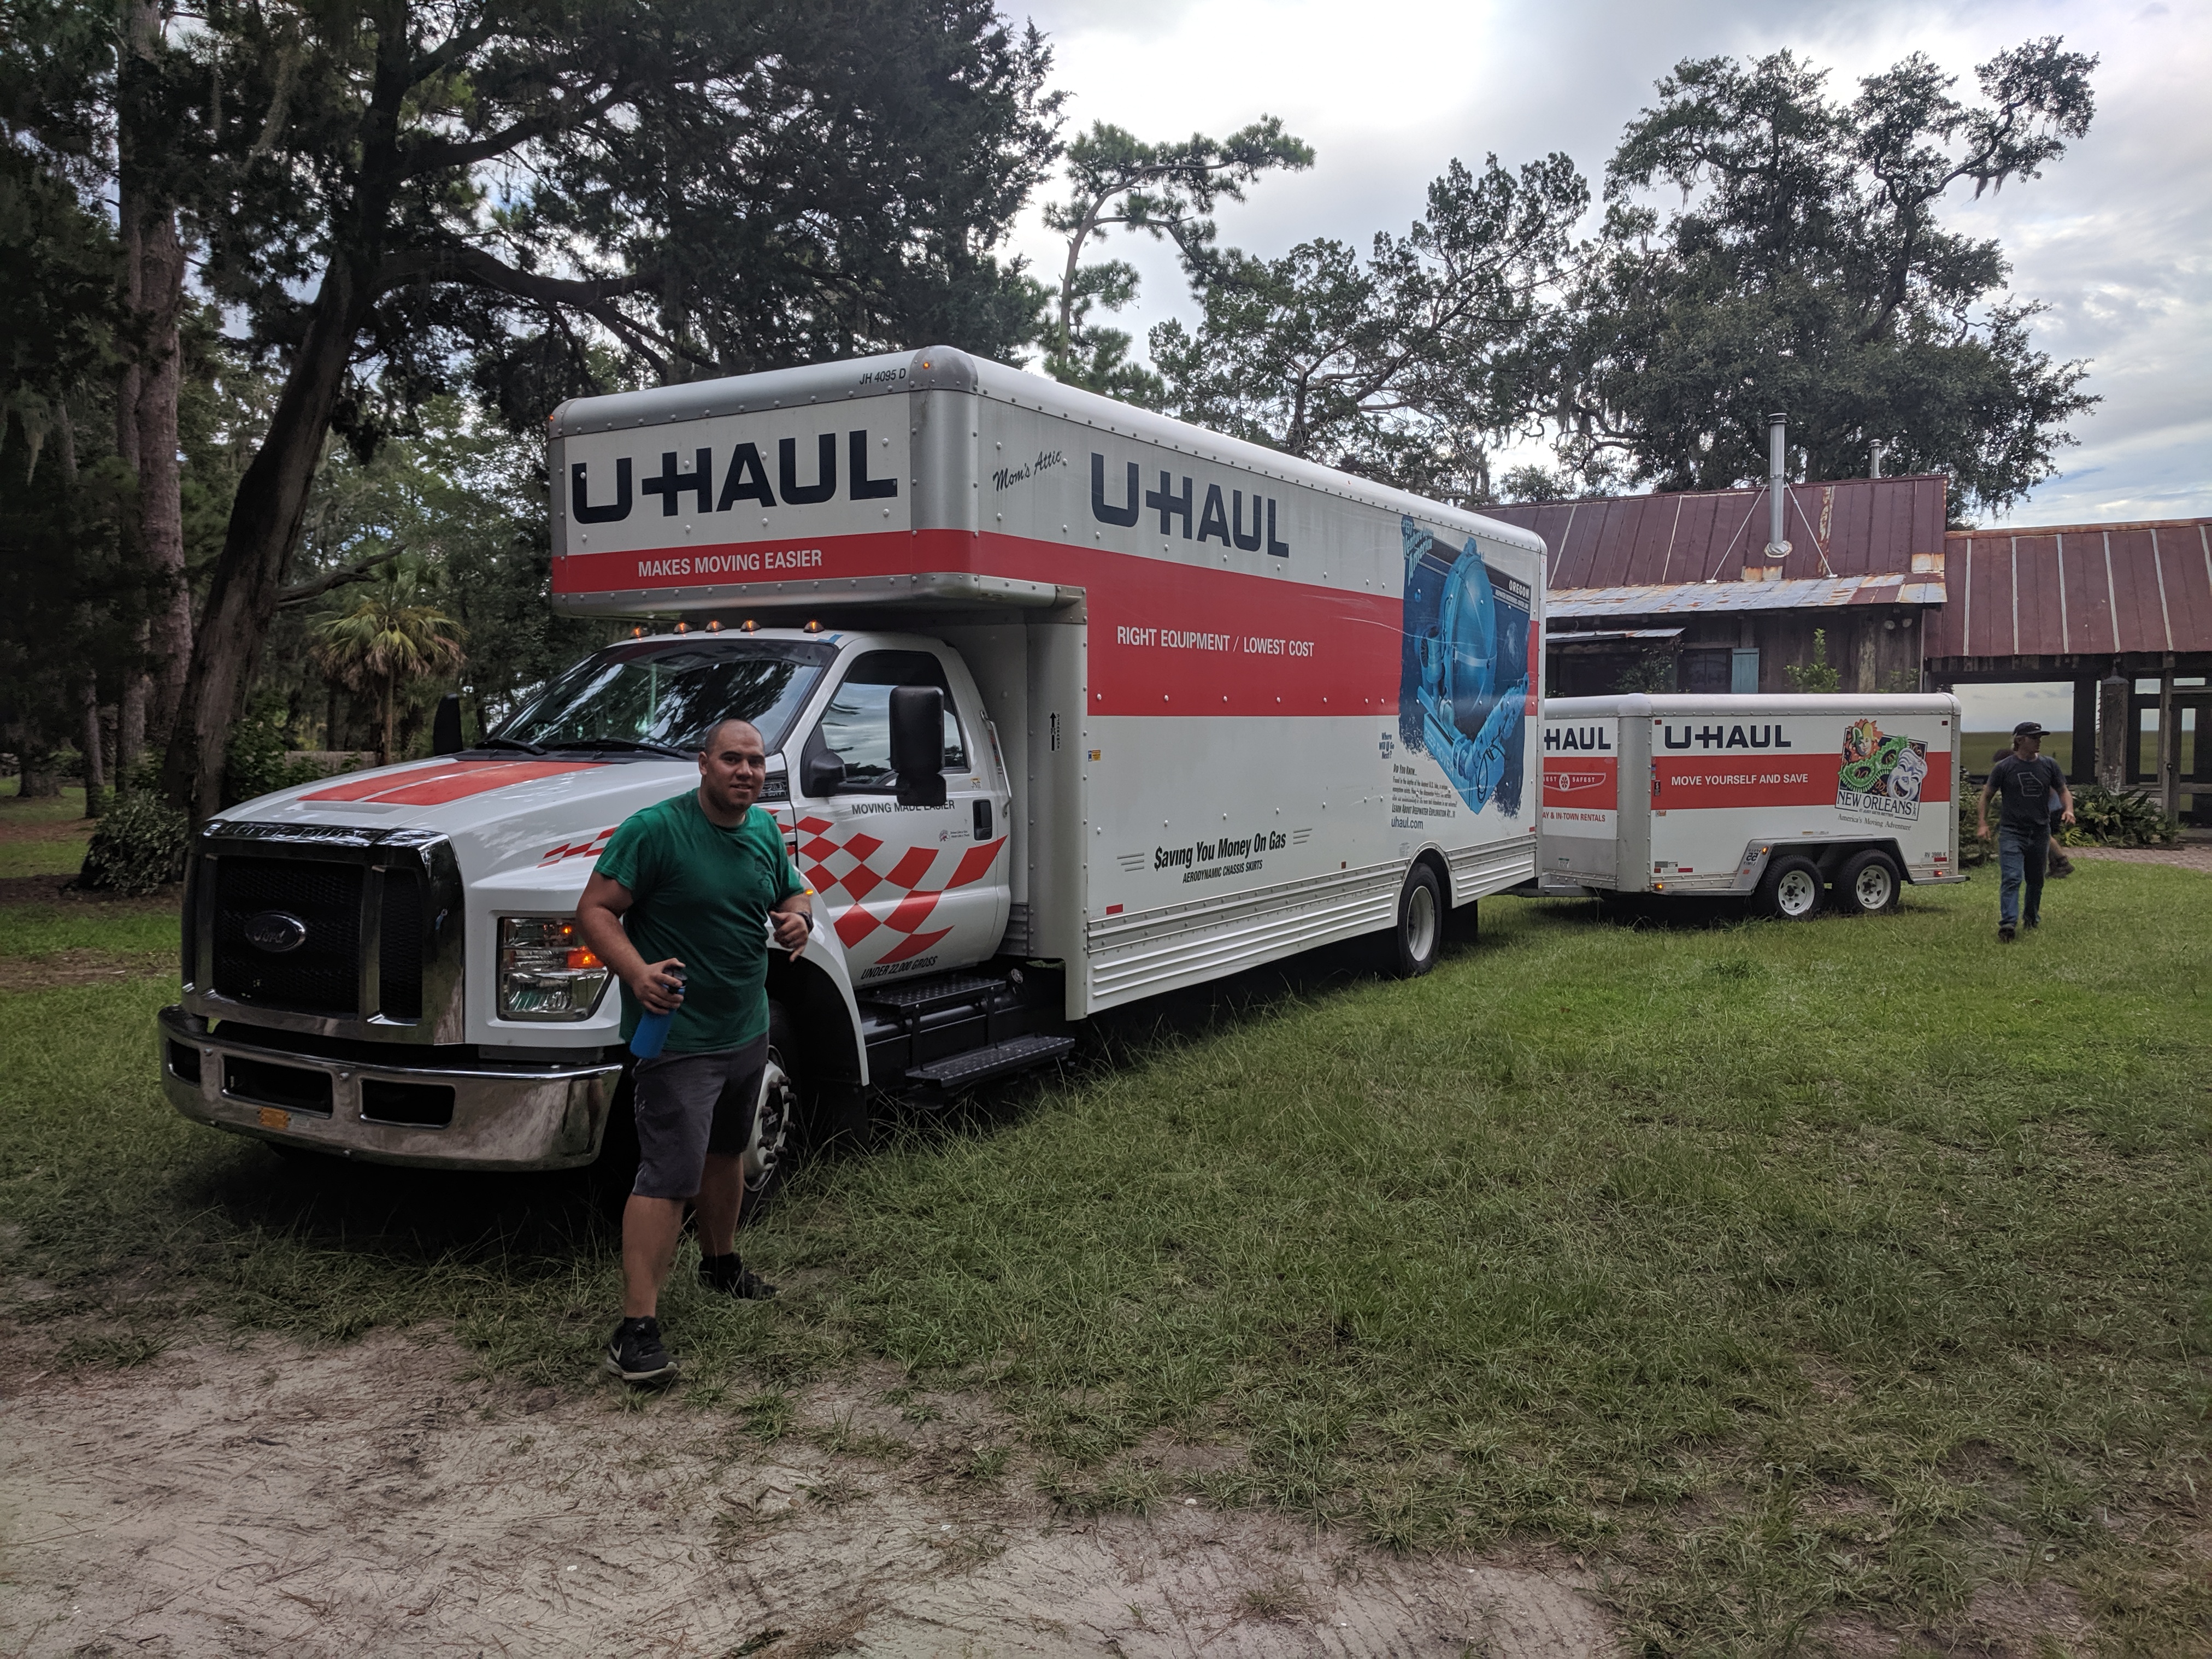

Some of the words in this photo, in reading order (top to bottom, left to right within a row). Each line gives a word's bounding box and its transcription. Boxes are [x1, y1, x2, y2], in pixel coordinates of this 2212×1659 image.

[859, 373, 873, 385] JH
[874, 369, 897, 383] 4095
[899, 368, 907, 379] D
[572, 430, 898, 525] U-HAUL
[992, 462, 1031, 492] Mom's
[1091, 452, 1290, 558] U-HAUL
[638, 558, 691, 577] MAKES
[695, 554, 760, 573] MOVING
[765, 549, 822, 569] EASIER
[1509, 579, 1529, 599] OREGON
[1117, 626, 1157, 646] RIGHT
[1161, 630, 1230, 651] EQUIPMENT
[1232, 636, 1239, 652] /
[1244, 637, 1286, 655] LOWEST
[1289, 640, 1314, 657] COST
[1544, 727, 1611, 750] HAUL
[1664, 725, 1791, 749] U-HAUL
[1671, 776, 1702, 786] MOVE
[1705, 774, 1757, 785] YOURSELF
[1759, 774, 1781, 784] AND
[1783, 773, 1809, 783] SAVE
[851, 803, 892, 815] MOVING
[1837, 791, 1862, 807] NEW
[1863, 795, 1912, 815] ORLEANS
[1556, 813, 1579, 821] IN-TOWN
[1580, 814, 1606, 822] RENTALS
[1838, 813, 1862, 824] America's
[1864, 817, 1884, 828] Moving
[1197, 841, 1215, 862] You
[1217, 838, 1252, 859] Money
[1254, 832, 1267, 853] On
[1269, 830, 1286, 850] Gas
[1182, 866, 1222, 884] AERODYNAMIC
[1223, 863, 1245, 877] CHASSIS
[1246, 860, 1263, 872] SKIRTS
[861, 965, 890, 980] UNDER
[911, 955, 938, 970] GROSS
